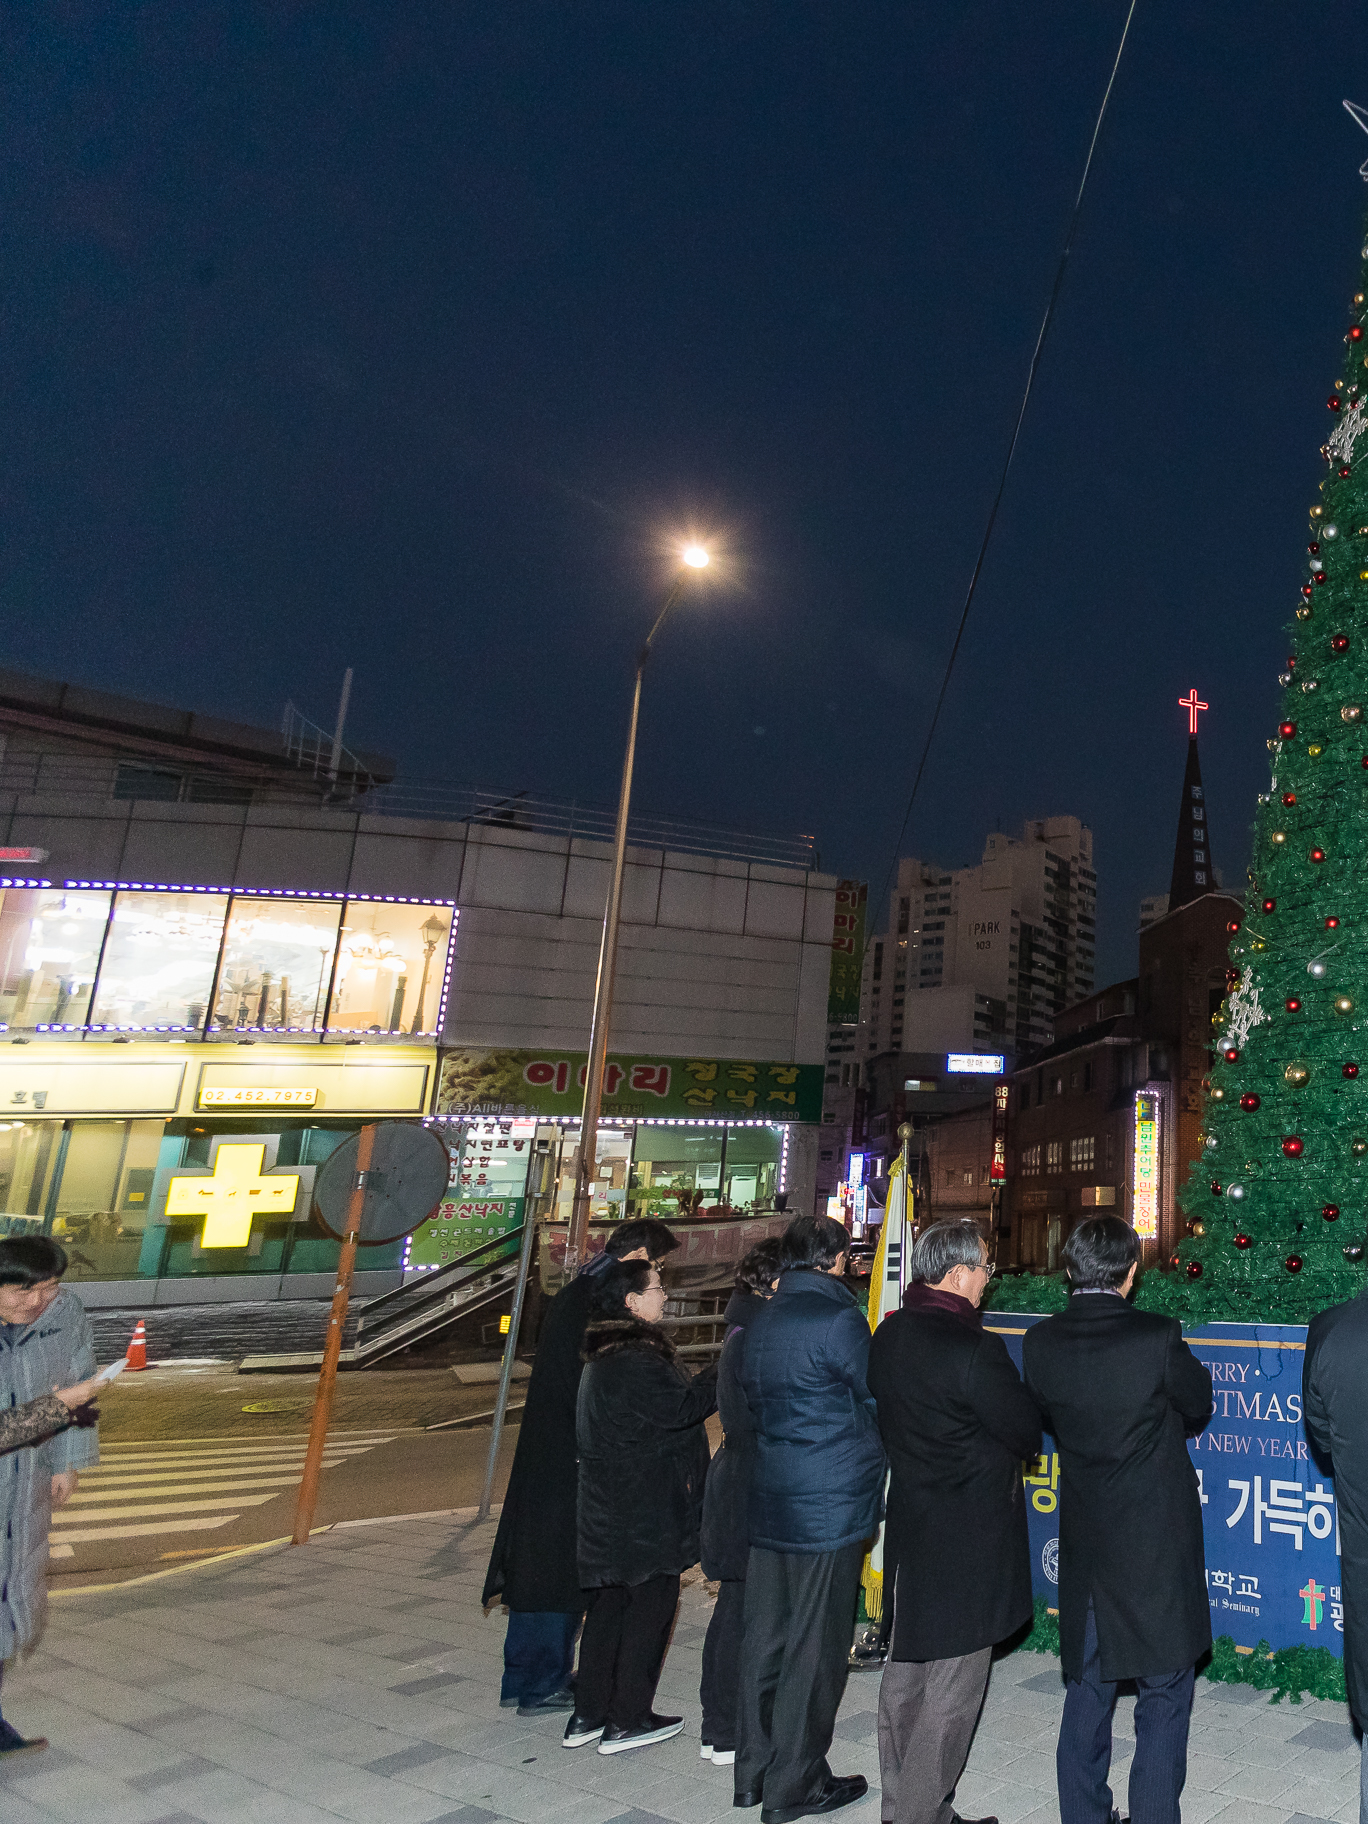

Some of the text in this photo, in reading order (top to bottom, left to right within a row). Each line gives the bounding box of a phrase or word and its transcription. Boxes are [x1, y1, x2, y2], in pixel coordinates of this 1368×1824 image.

[976, 941, 991, 950] 103
[205, 1091, 313, 1101] 02.452.7975
[1208, 1432, 1252, 1455] NEW
[1257, 1437, 1309, 1461] YEAR
[1206, 1568, 1261, 1599] 학교
[1221, 1598, 1260, 1616] Seminary
